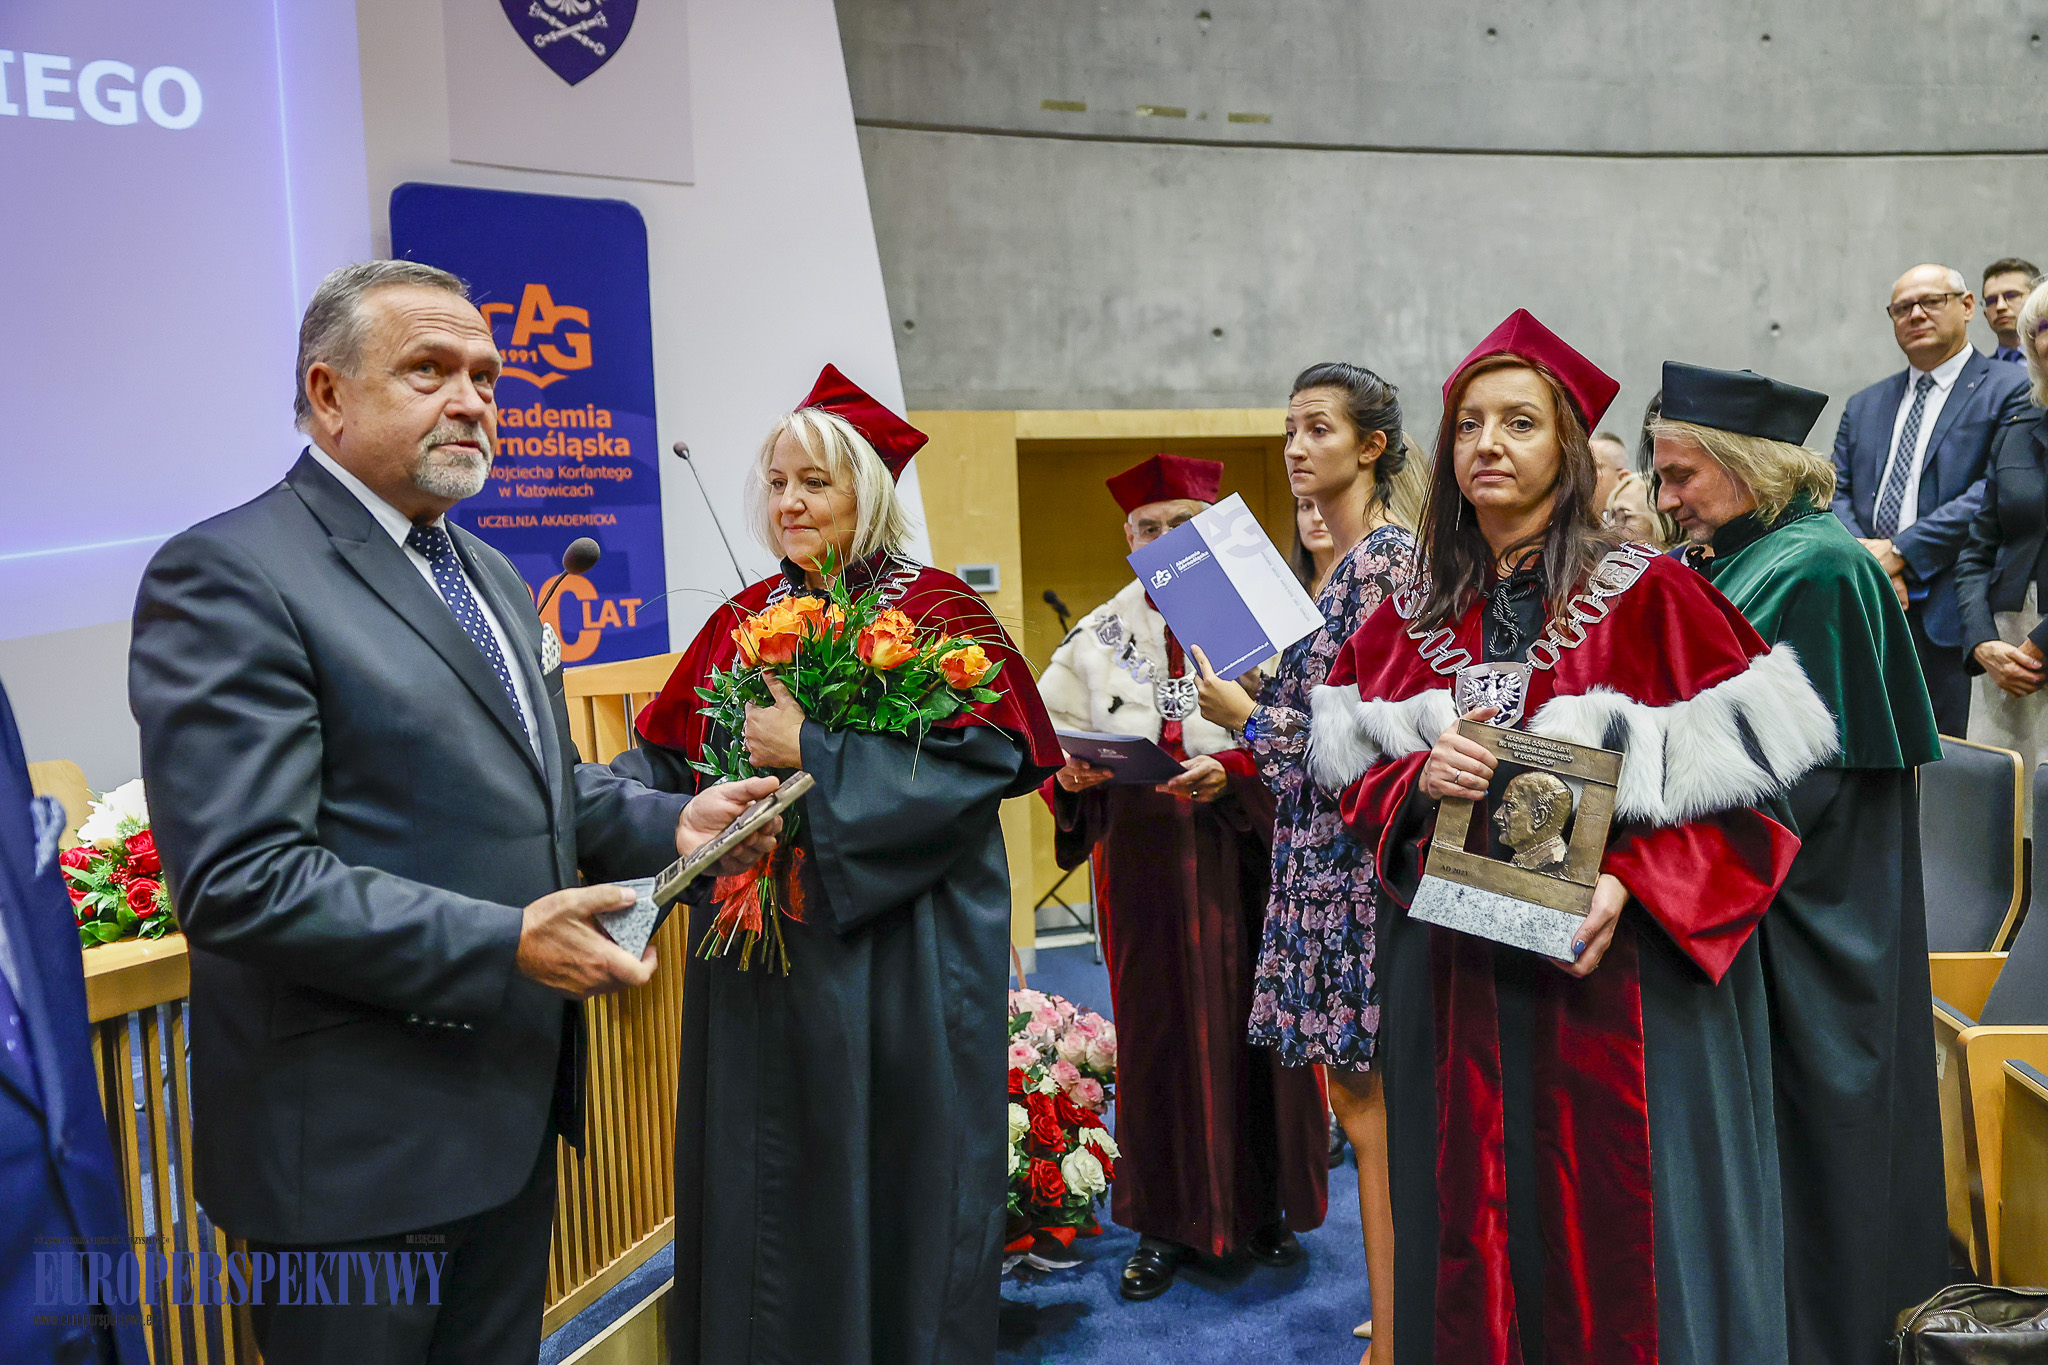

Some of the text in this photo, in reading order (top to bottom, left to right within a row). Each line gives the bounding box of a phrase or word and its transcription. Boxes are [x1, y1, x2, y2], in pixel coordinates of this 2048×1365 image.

[496, 402, 612, 428] kademia
[495, 430, 631, 462] rnośląska
[558, 465, 633, 482] Korfantego
[498, 483, 595, 498] w Katowicach
[477, 513, 617, 529] UCZELNIA AKADEMICKA
[582, 598, 642, 630] LAT
